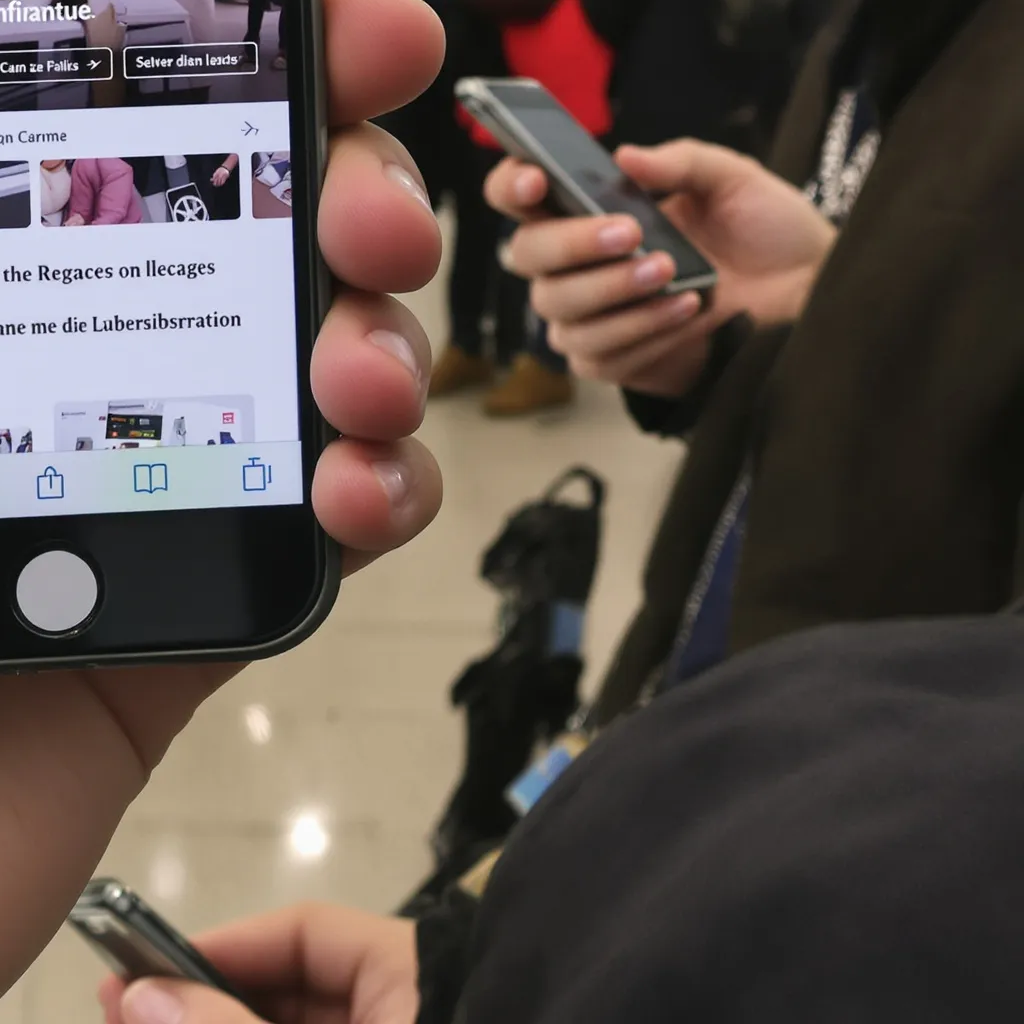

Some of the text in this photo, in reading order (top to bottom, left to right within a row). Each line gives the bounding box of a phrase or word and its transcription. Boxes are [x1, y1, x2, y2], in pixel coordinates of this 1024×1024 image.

[3, 265, 32, 282] the
[38, 264, 113, 284] Regaces
[118, 266, 141, 279] on
[31, 321, 57, 334] me
[62, 317, 87, 333] die
